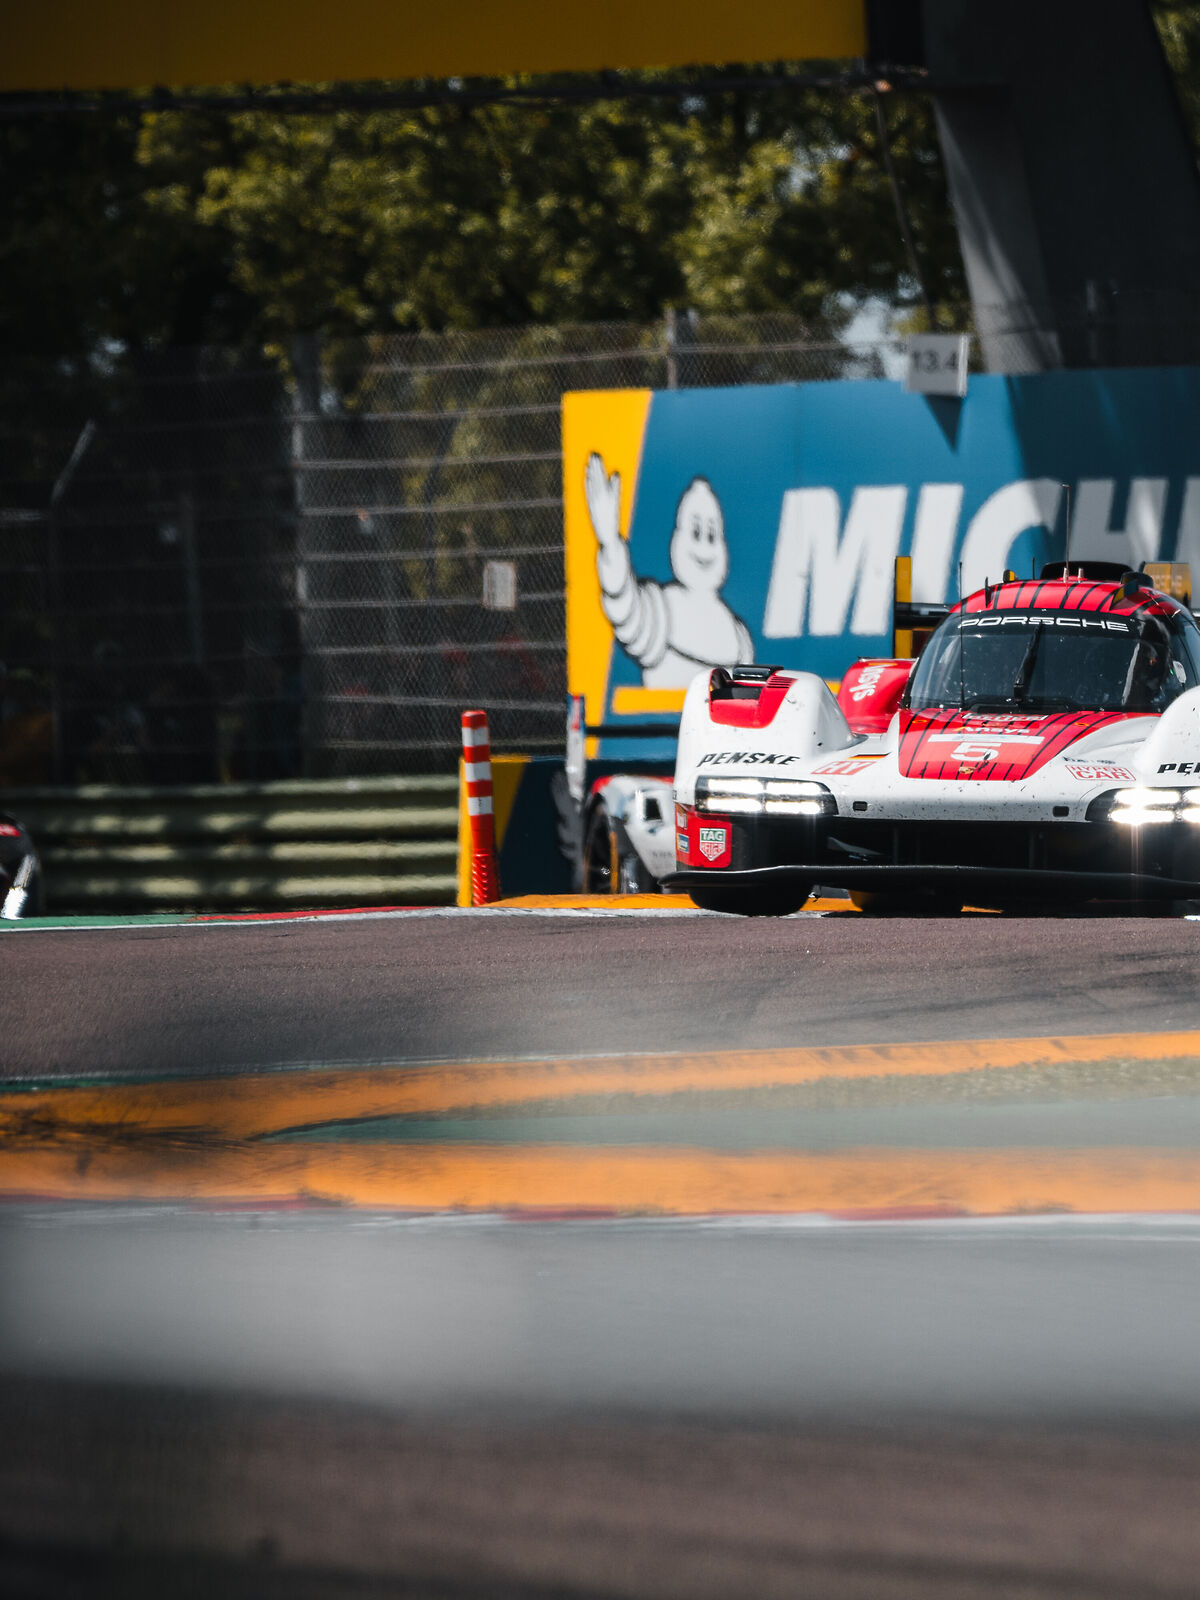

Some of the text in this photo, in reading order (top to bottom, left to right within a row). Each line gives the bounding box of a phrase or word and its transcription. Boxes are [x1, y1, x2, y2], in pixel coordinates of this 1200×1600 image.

[957, 616, 1129, 632] PORSCHE
[697, 751, 800, 768] PENSKE
[950, 742, 1002, 762] 5
[1075, 770, 1131, 780] CAR
[701, 830, 723, 841] TAG
